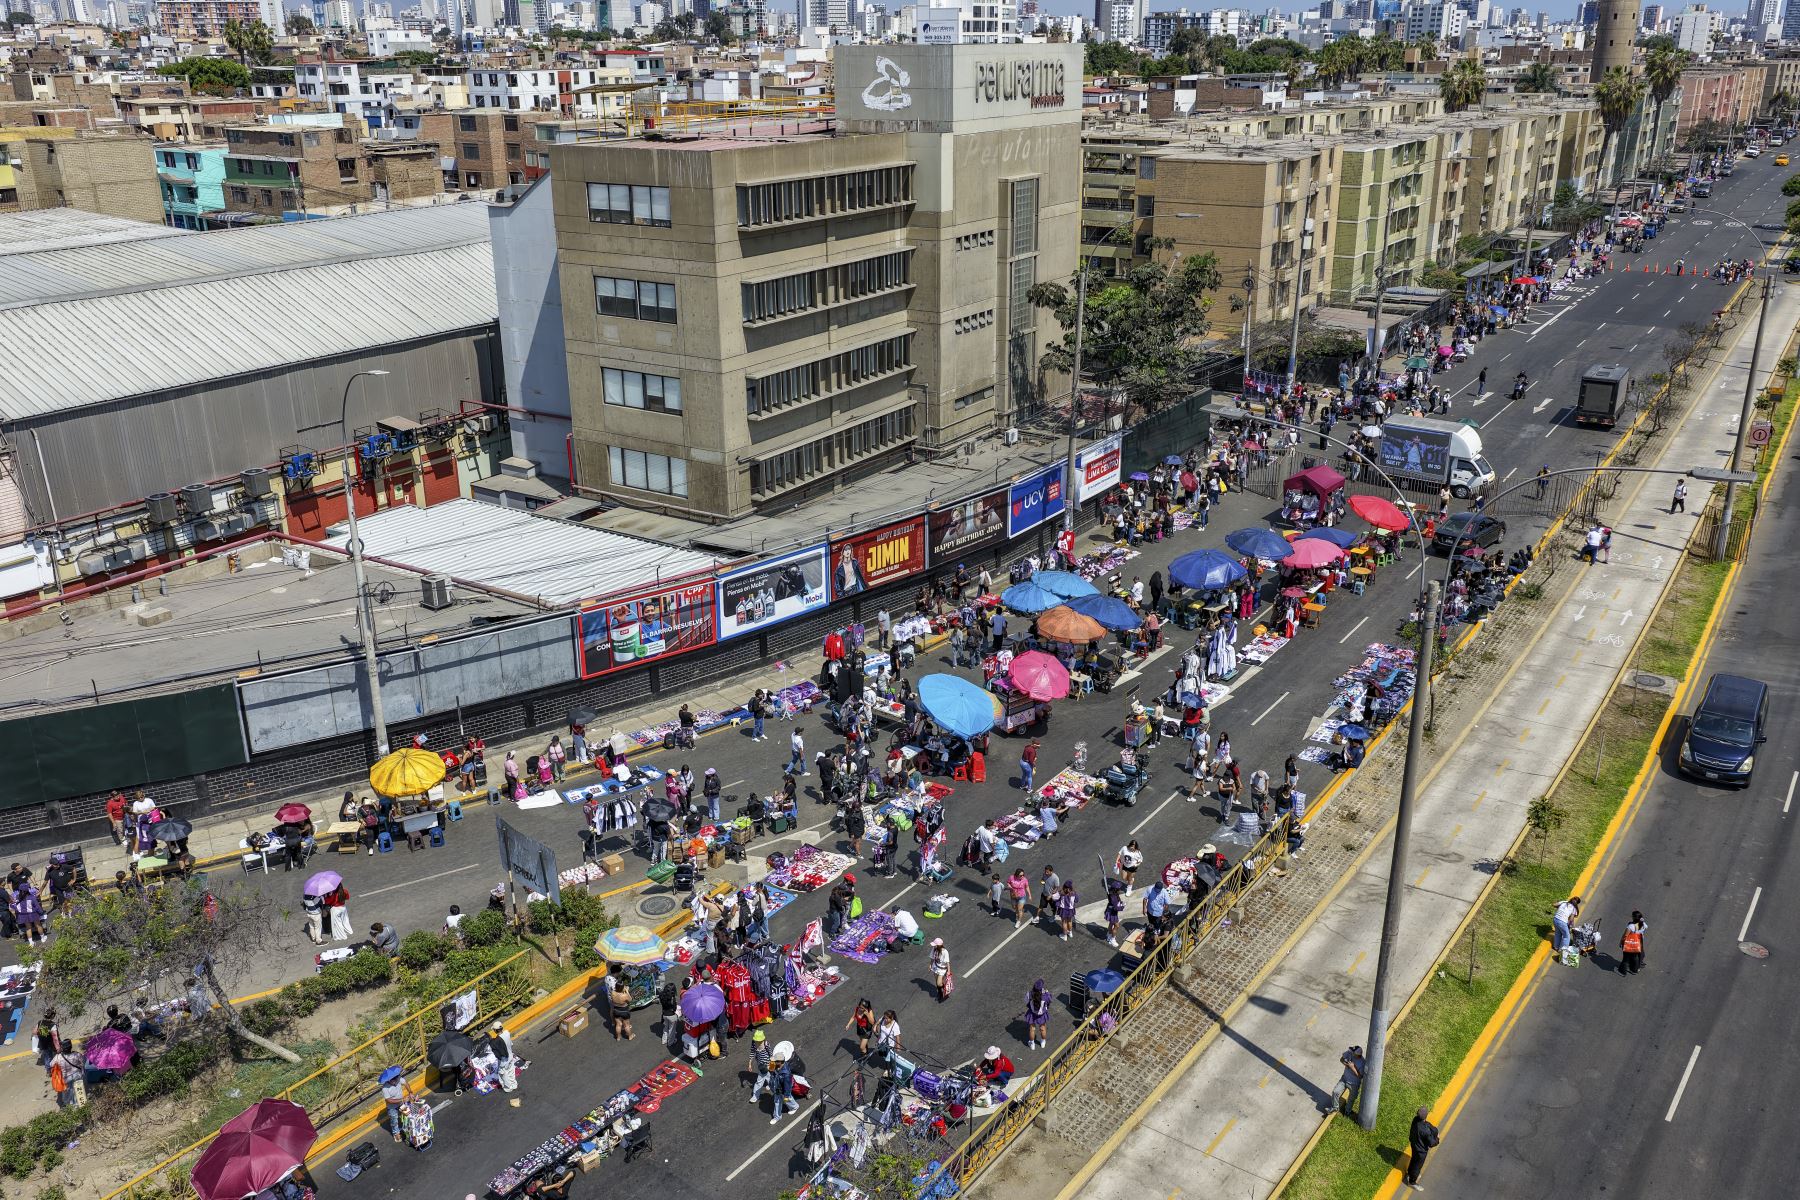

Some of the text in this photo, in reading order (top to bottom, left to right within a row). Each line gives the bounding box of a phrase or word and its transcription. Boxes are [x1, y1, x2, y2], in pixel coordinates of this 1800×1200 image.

[1088, 459, 1118, 479] LIMA CENTRO
[1024, 486, 1045, 508] UCV
[934, 540, 956, 553] HAPPY
[986, 522, 1003, 534] JIMIN
[866, 536, 909, 572] JIMIN
[687, 585, 704, 596] CPP
[727, 586, 743, 597] Piensa
[805, 592, 823, 604] Mobil
[596, 643, 611, 652] CON
[649, 627, 673, 638] BARRIO
[673, 617, 704, 631] RESUELVE
